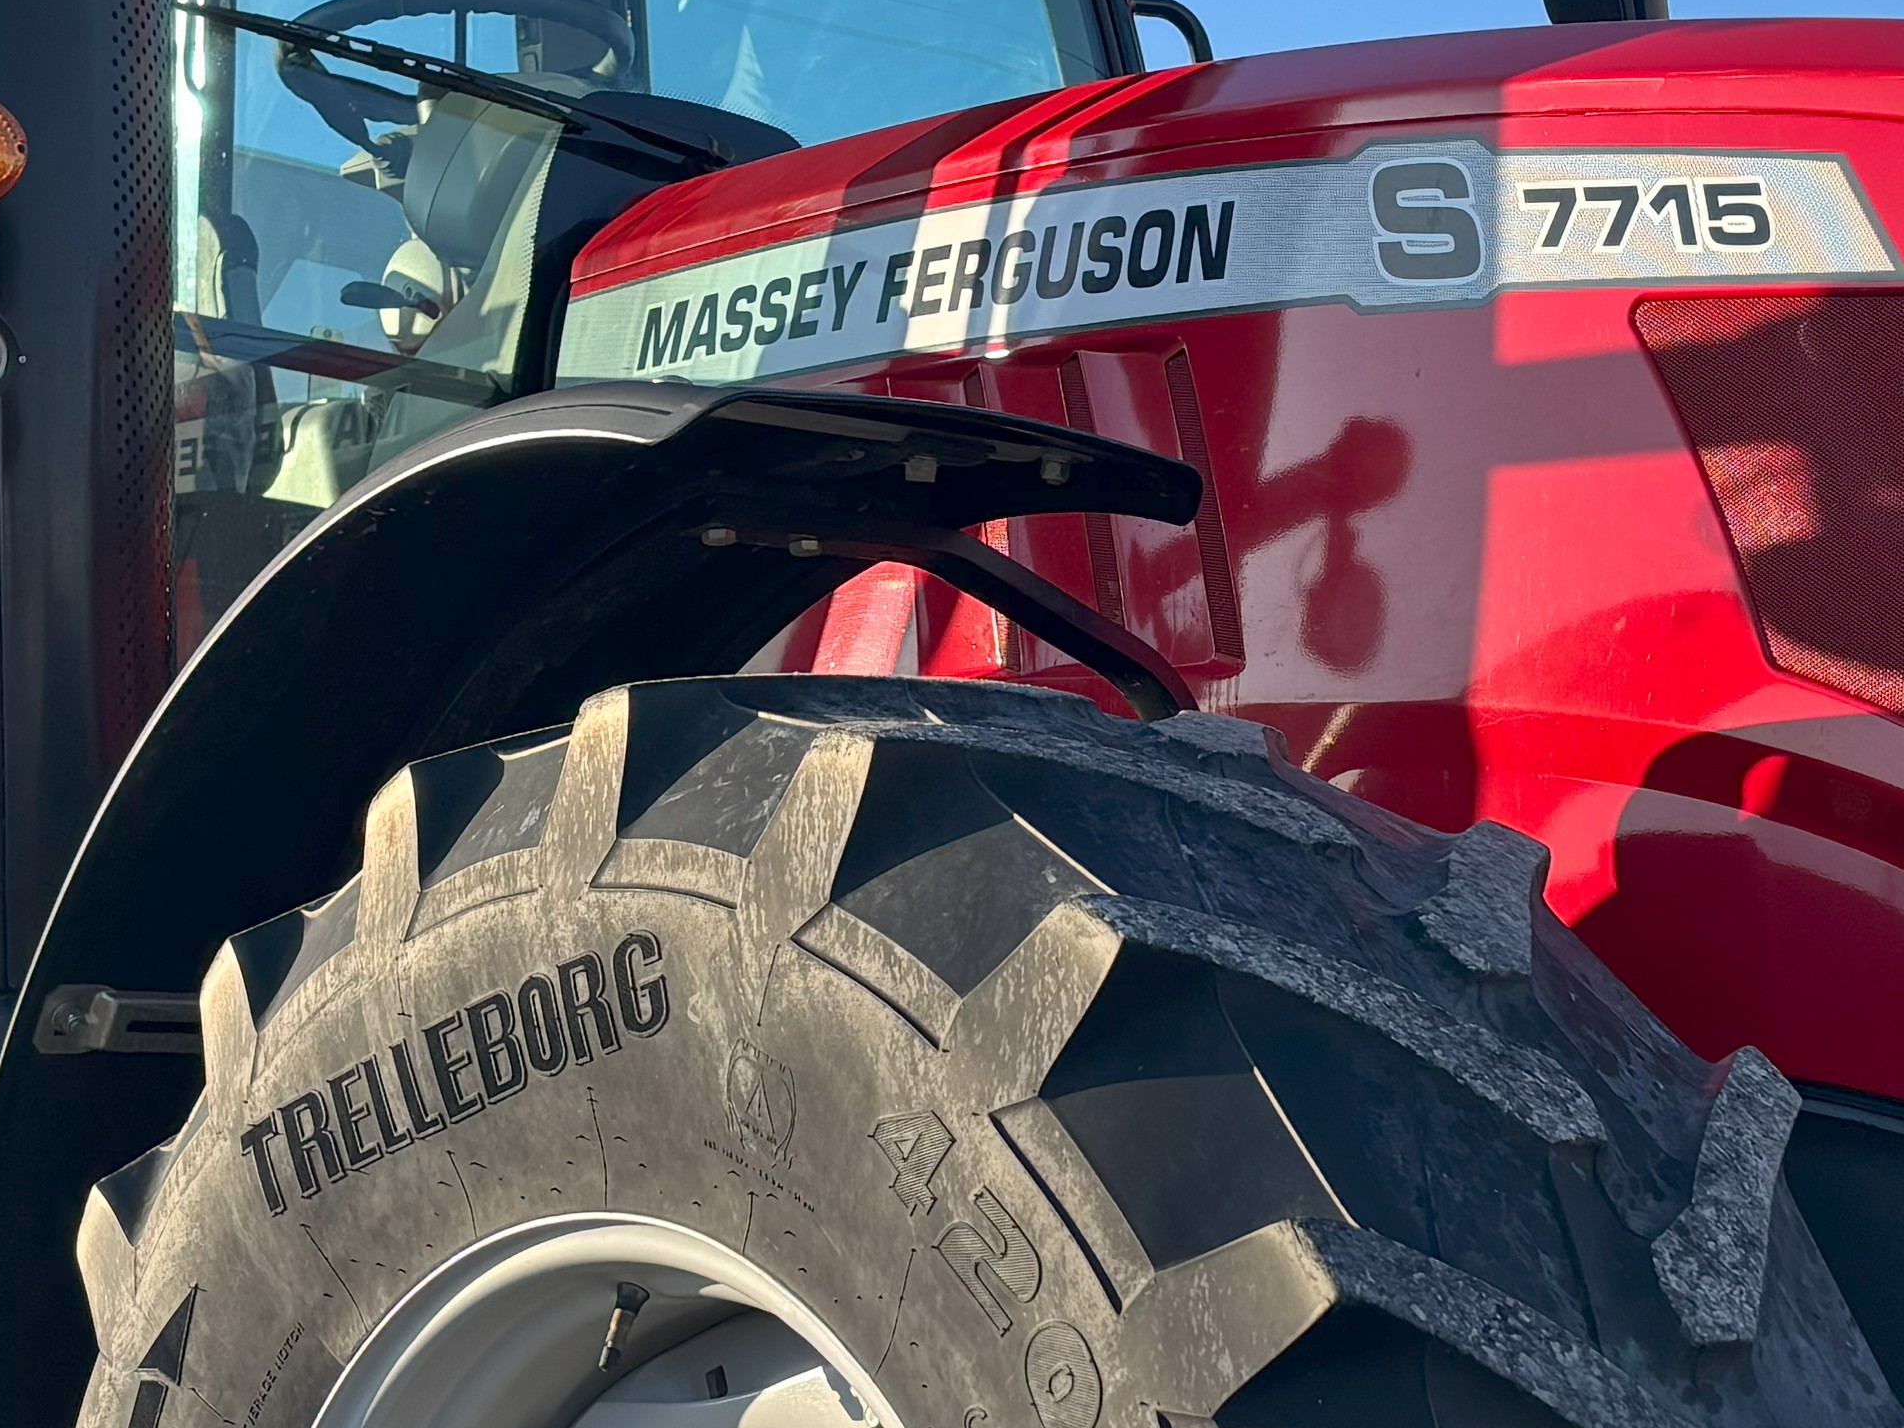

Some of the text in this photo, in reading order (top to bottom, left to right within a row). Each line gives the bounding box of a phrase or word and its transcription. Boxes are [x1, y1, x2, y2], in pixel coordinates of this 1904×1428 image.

[637, 160, 1771, 374] MASSEY FERGUSON S 7715
[239, 930, 672, 1220] TRELLEBORG
